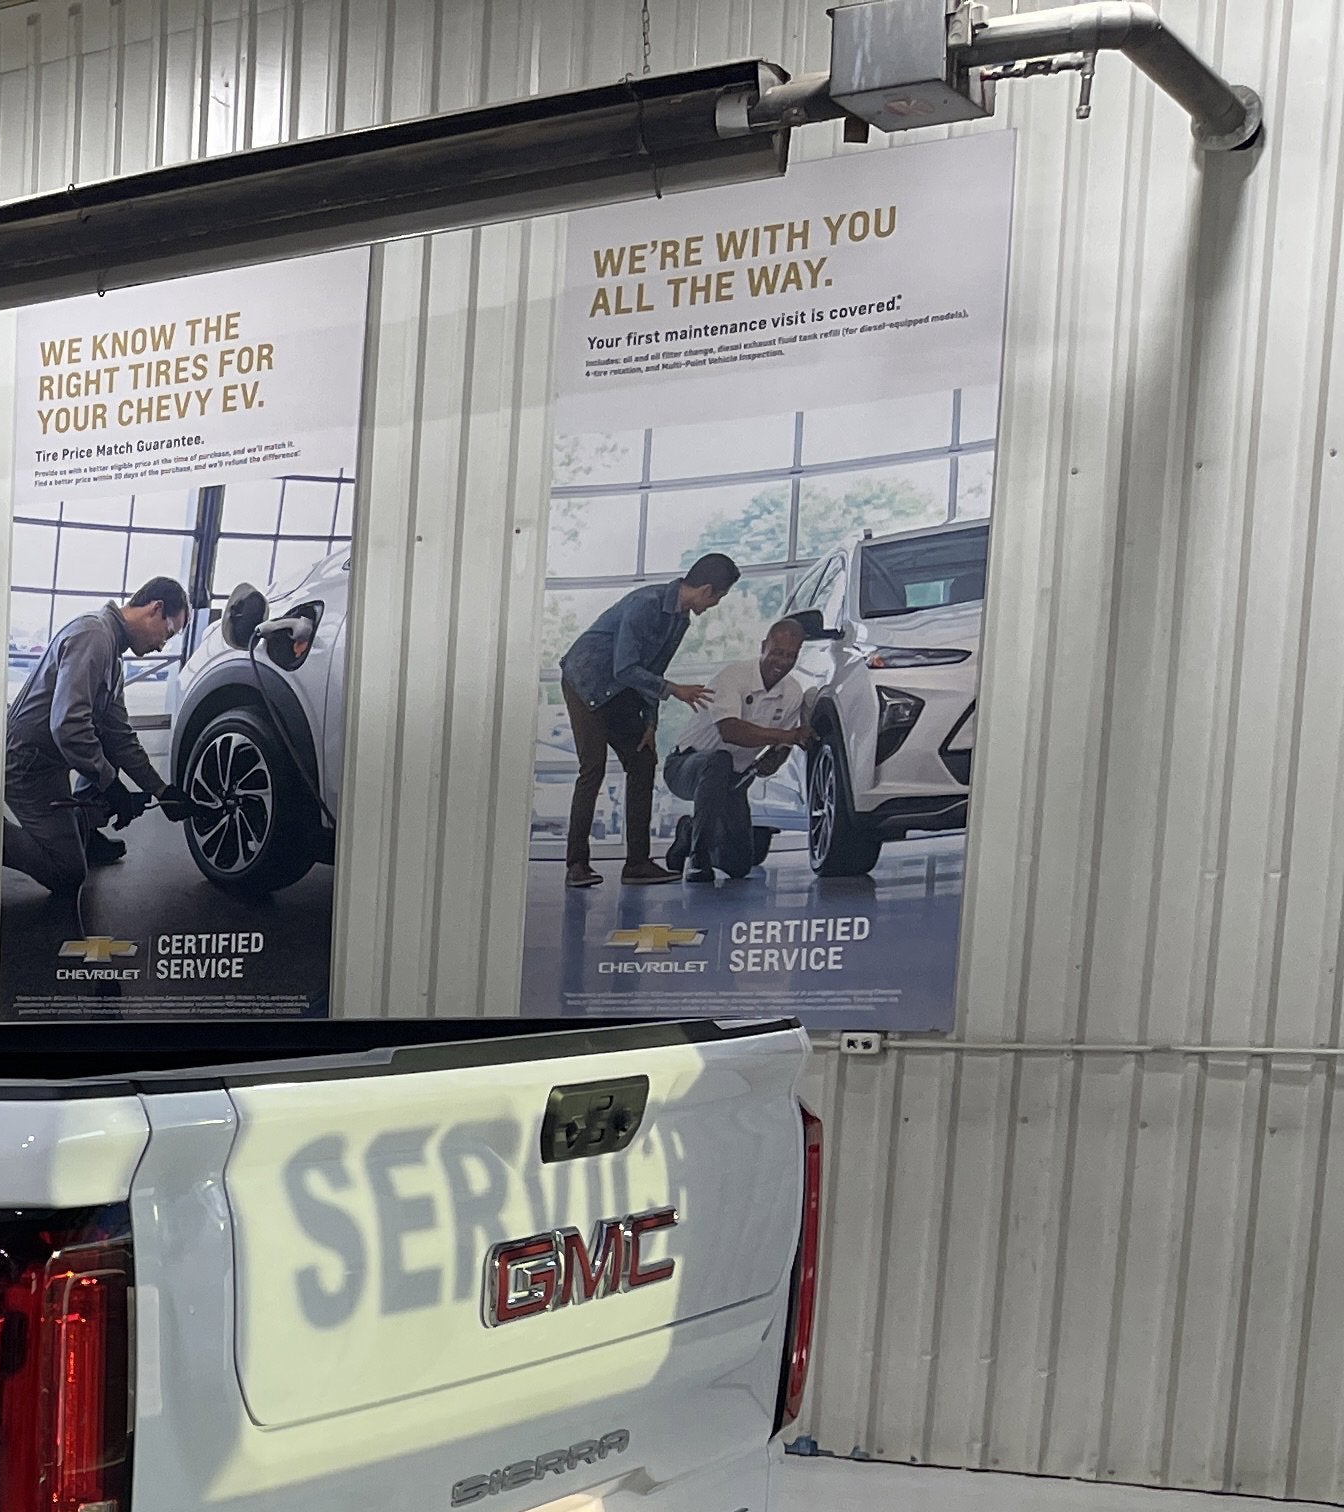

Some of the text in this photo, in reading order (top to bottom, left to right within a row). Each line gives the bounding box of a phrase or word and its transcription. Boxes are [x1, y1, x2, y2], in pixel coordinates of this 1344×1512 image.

[593, 205, 897, 279] WE'RE WITH YOU
[589, 256, 833, 318] ALL THE WAY.
[40, 312, 241, 367] WE KNOW THE
[587, 336, 622, 350] Your
[626, 330, 660, 347] first
[664, 318, 767, 343] maintenance
[771, 311, 806, 328] visit
[811, 308, 824, 323] is
[38, 343, 274, 401] RIGHT TIRES FOR
[37, 381, 265, 435] YOUR CHEVY EV.
[35, 434, 205, 463] Tire Price Match Guarantee.
[157, 932, 264, 955] CERTIFIED
[730, 916, 870, 945] CERTIFIED
[56, 968, 140, 981] CHEVROLET
[156, 957, 244, 980] SERVICE
[598, 960, 708, 974] CHEVROLET
[729, 946, 843, 973] SERVICE
[480, 1204, 681, 1329] GMC
[450, 1428, 631, 1508] SIERRA
